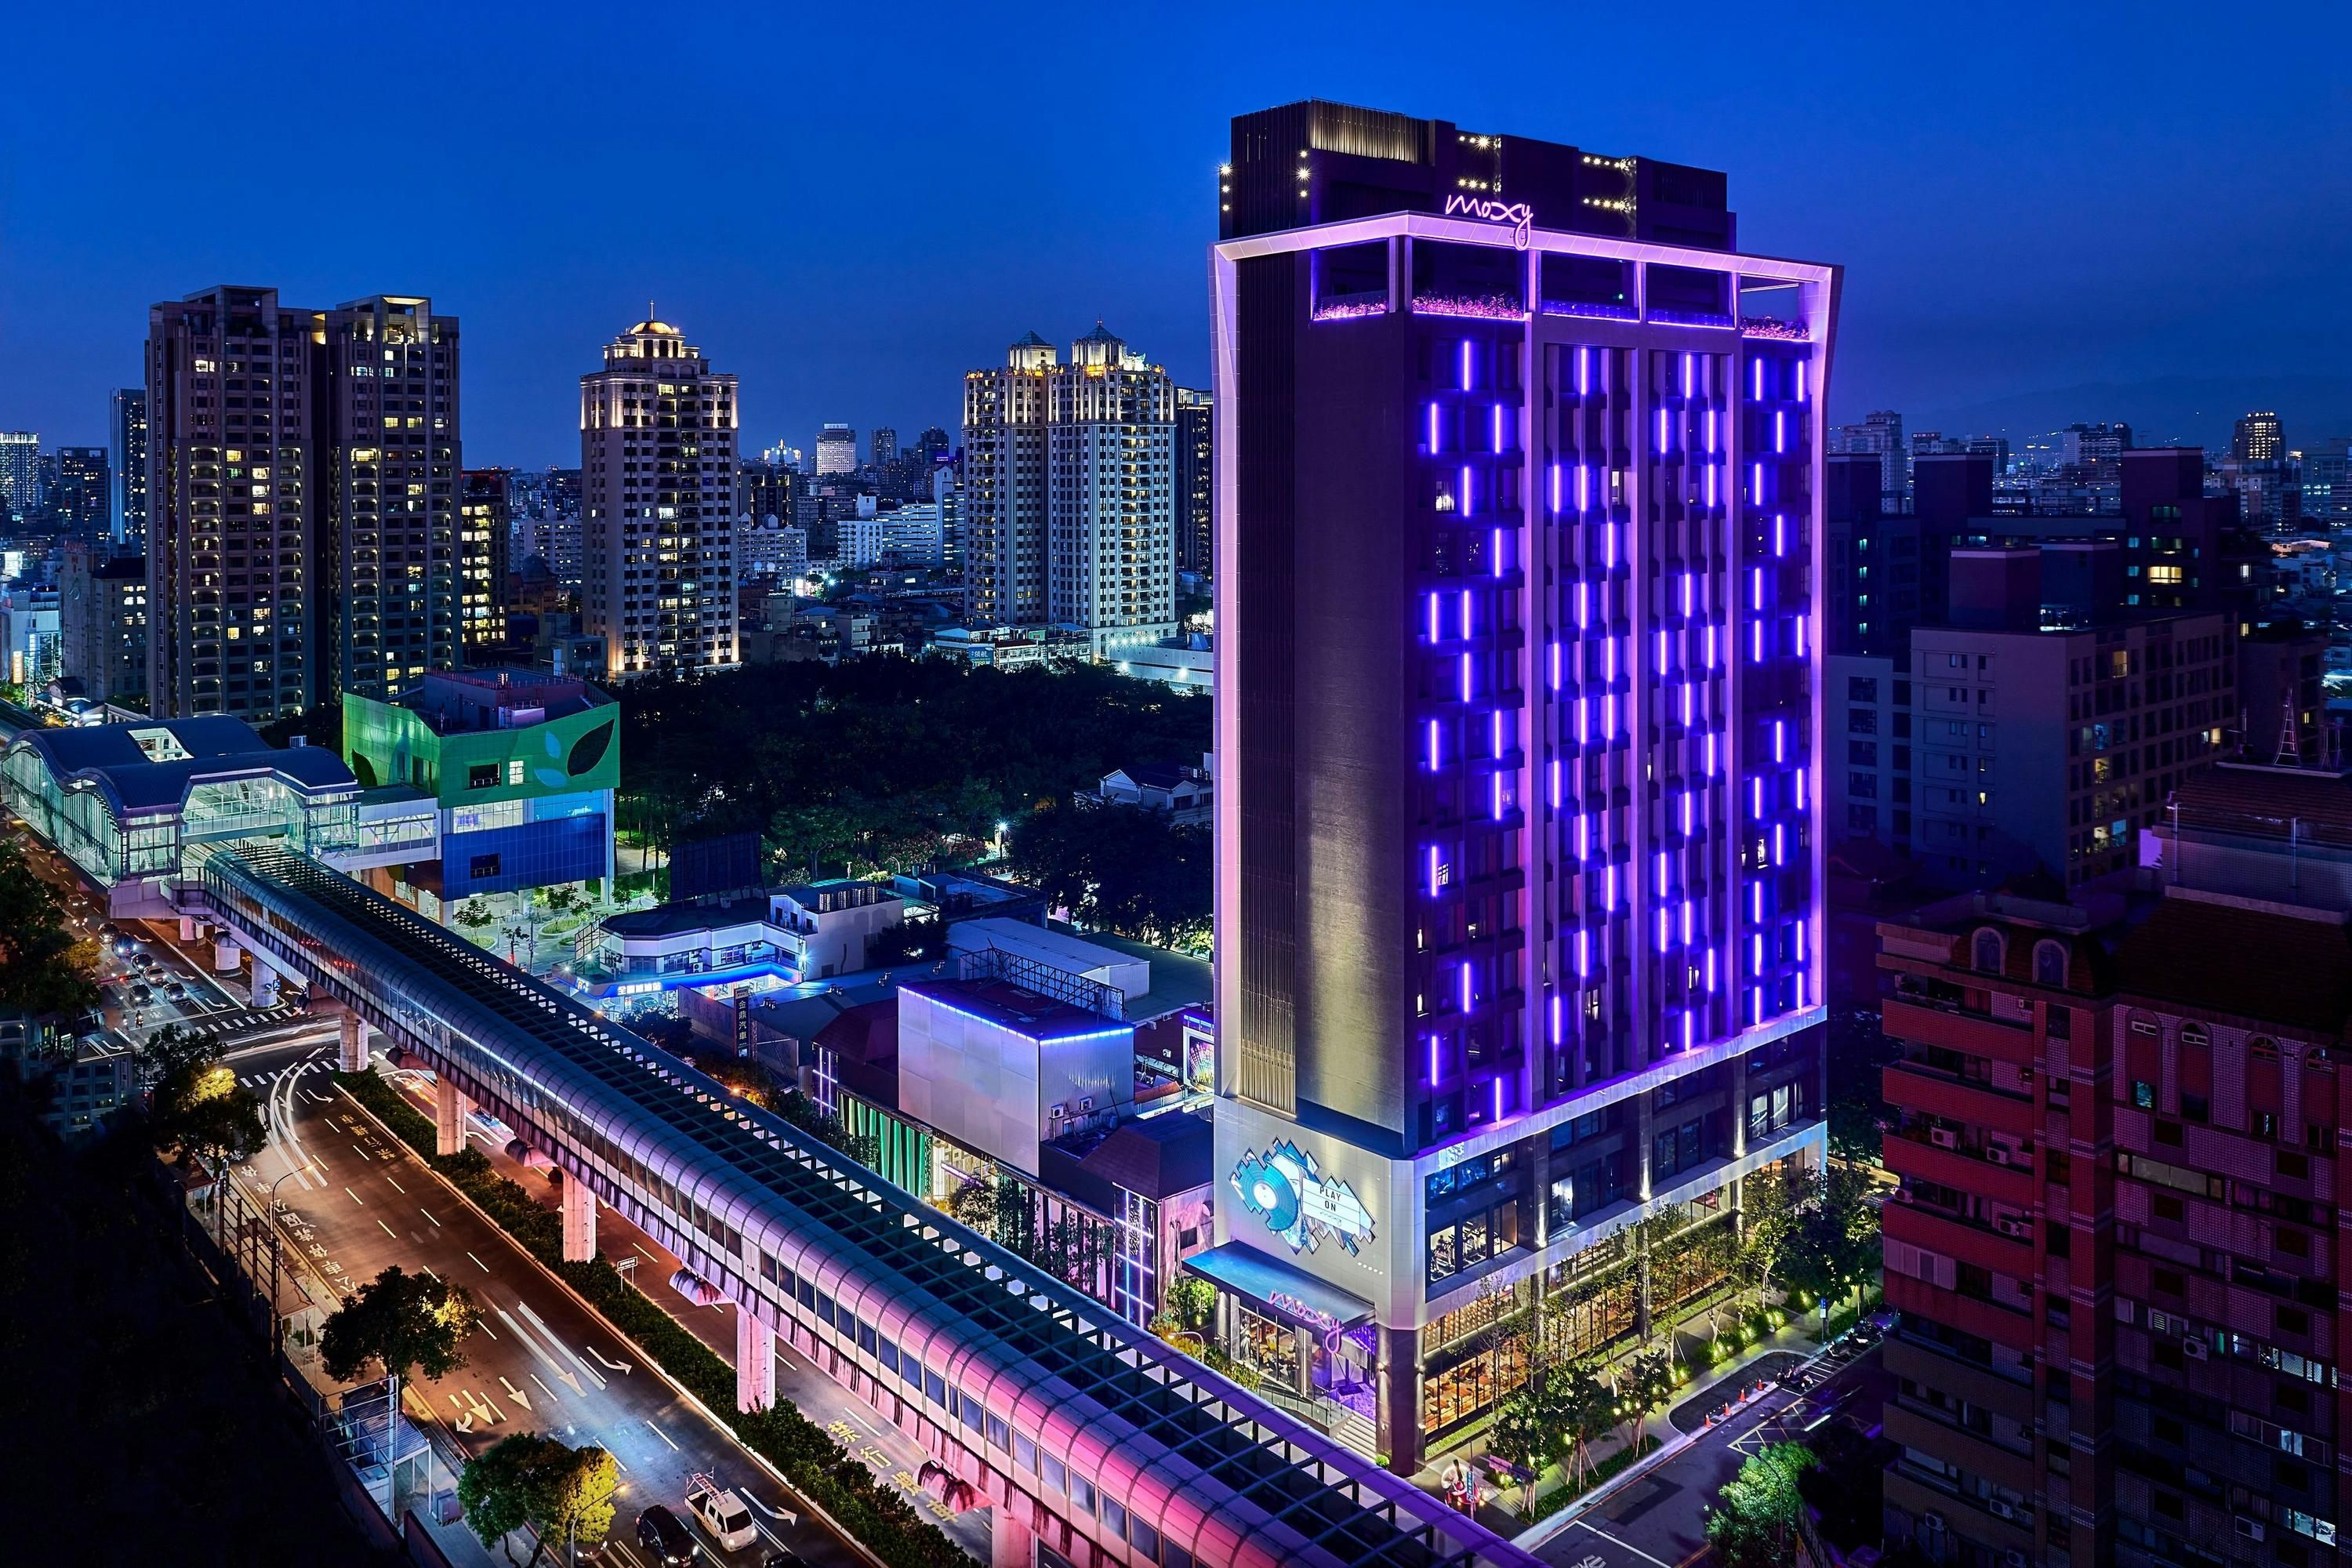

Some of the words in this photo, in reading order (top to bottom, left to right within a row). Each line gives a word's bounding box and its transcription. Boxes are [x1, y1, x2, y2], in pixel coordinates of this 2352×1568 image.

[739, 1000, 747, 1040] 金鼎汽車
[1319, 1186, 1341, 1201] PLAY
[1325, 1200, 1336, 1212] ON
[827, 1420, 958, 1523] 禁行機車
